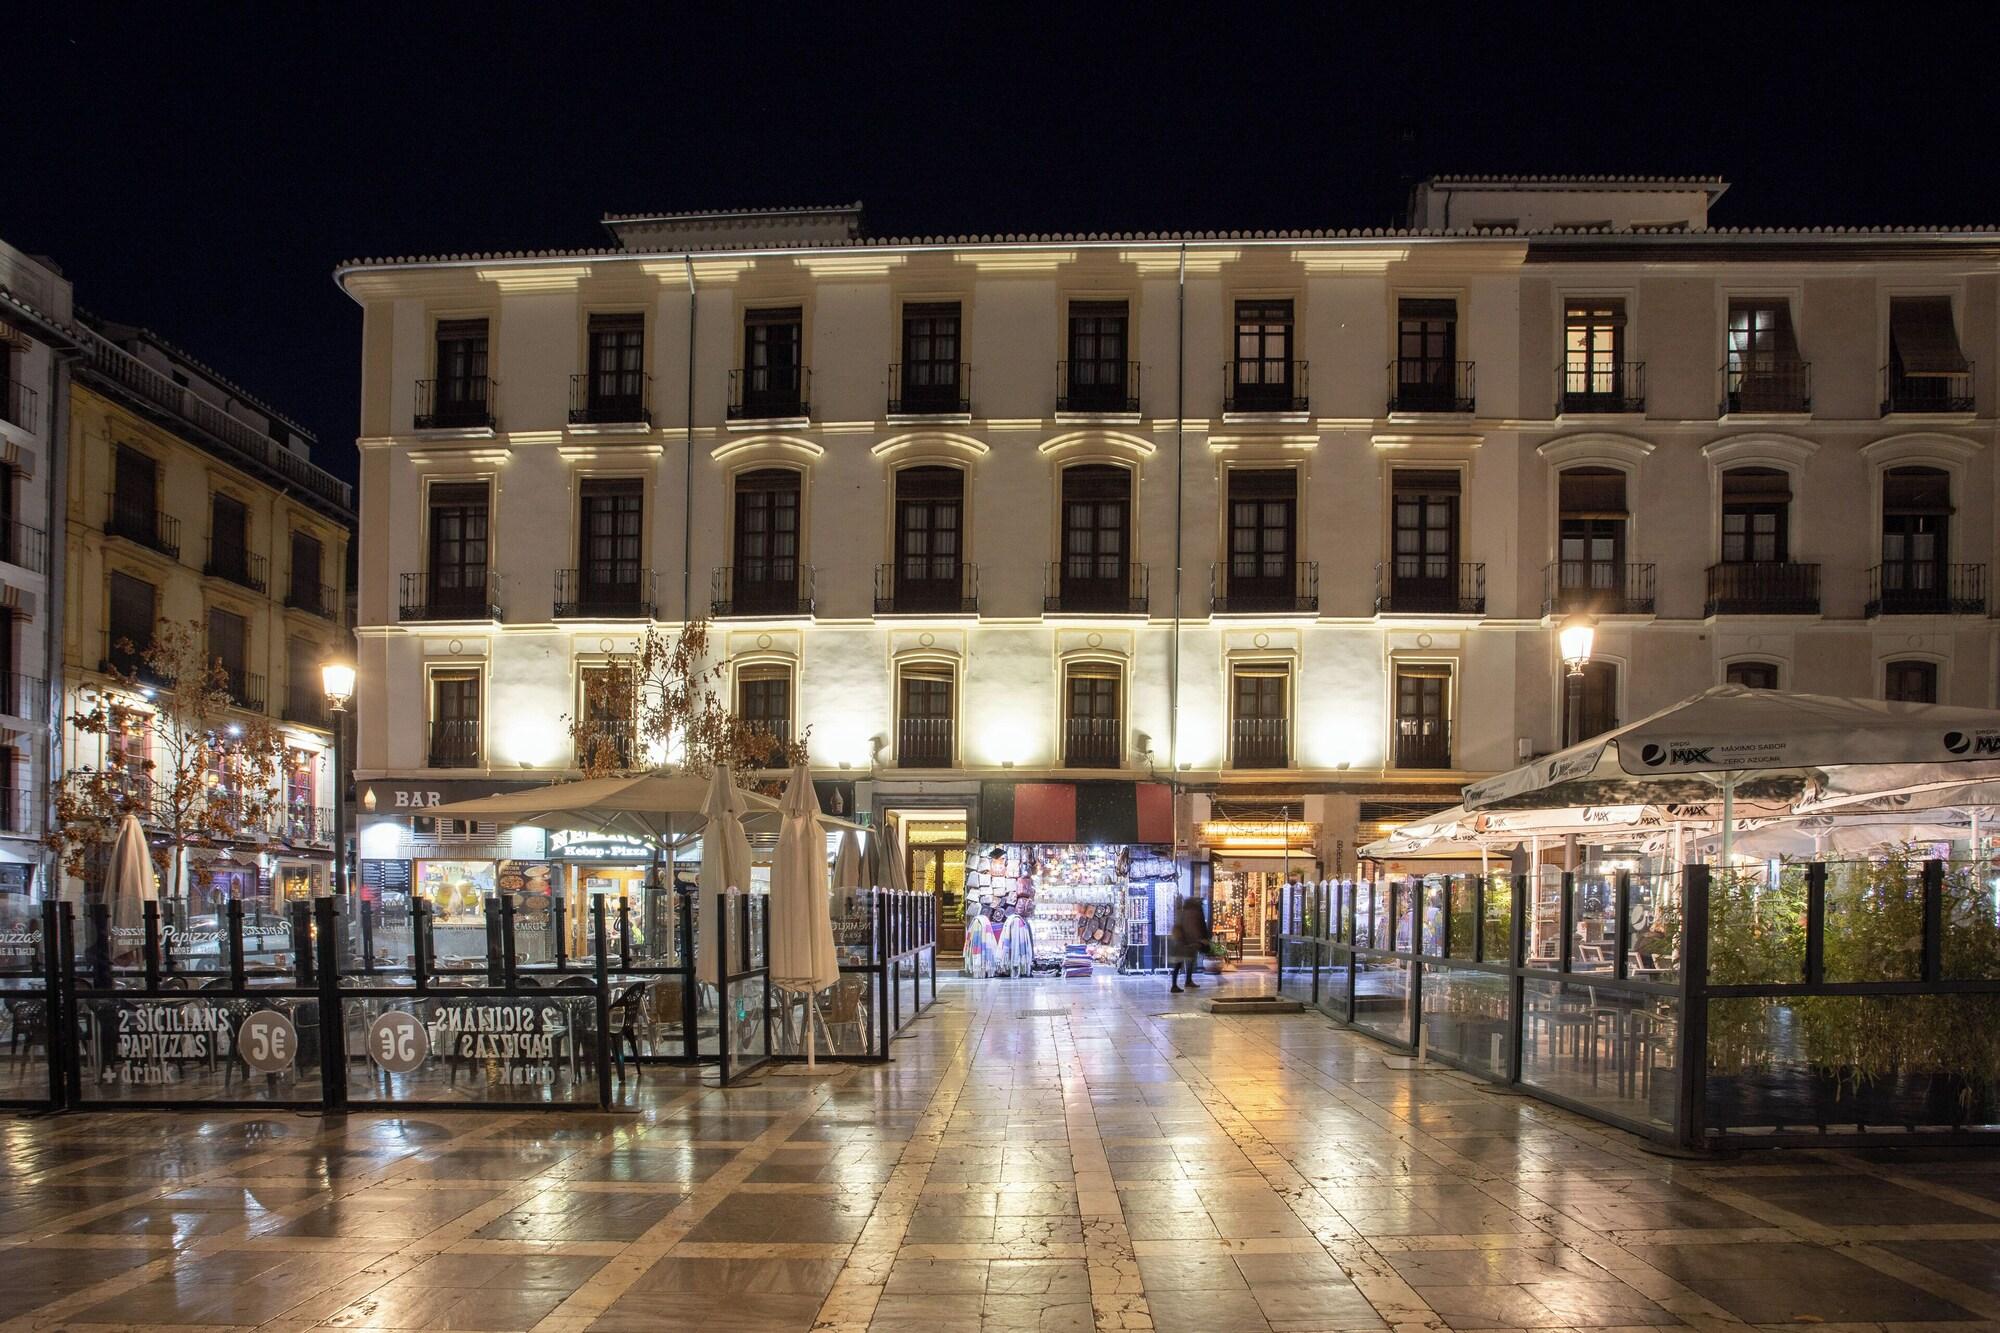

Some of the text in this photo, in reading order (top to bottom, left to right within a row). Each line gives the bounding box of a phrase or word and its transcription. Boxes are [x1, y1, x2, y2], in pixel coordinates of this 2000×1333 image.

[1669, 746, 1716, 765] MAX
[1721, 743, 1755, 753] MÁXIMO
[1723, 757, 1745, 765] ZERO
[394, 791, 441, 808] BAR
[1594, 811, 1610, 822] MAX
[1682, 805, 1710, 817] MAX
[1207, 822, 1253, 837] PLAZA
[1640, 816, 1662, 826] MAX
[160, 925, 219, 946] Papizza
[118, 1007, 230, 1032] 2 SICILIANS
[118, 1034, 207, 1058] PAPIZZAS
[251, 1023, 286, 1061] 5€
[121, 1060, 175, 1084] drink
